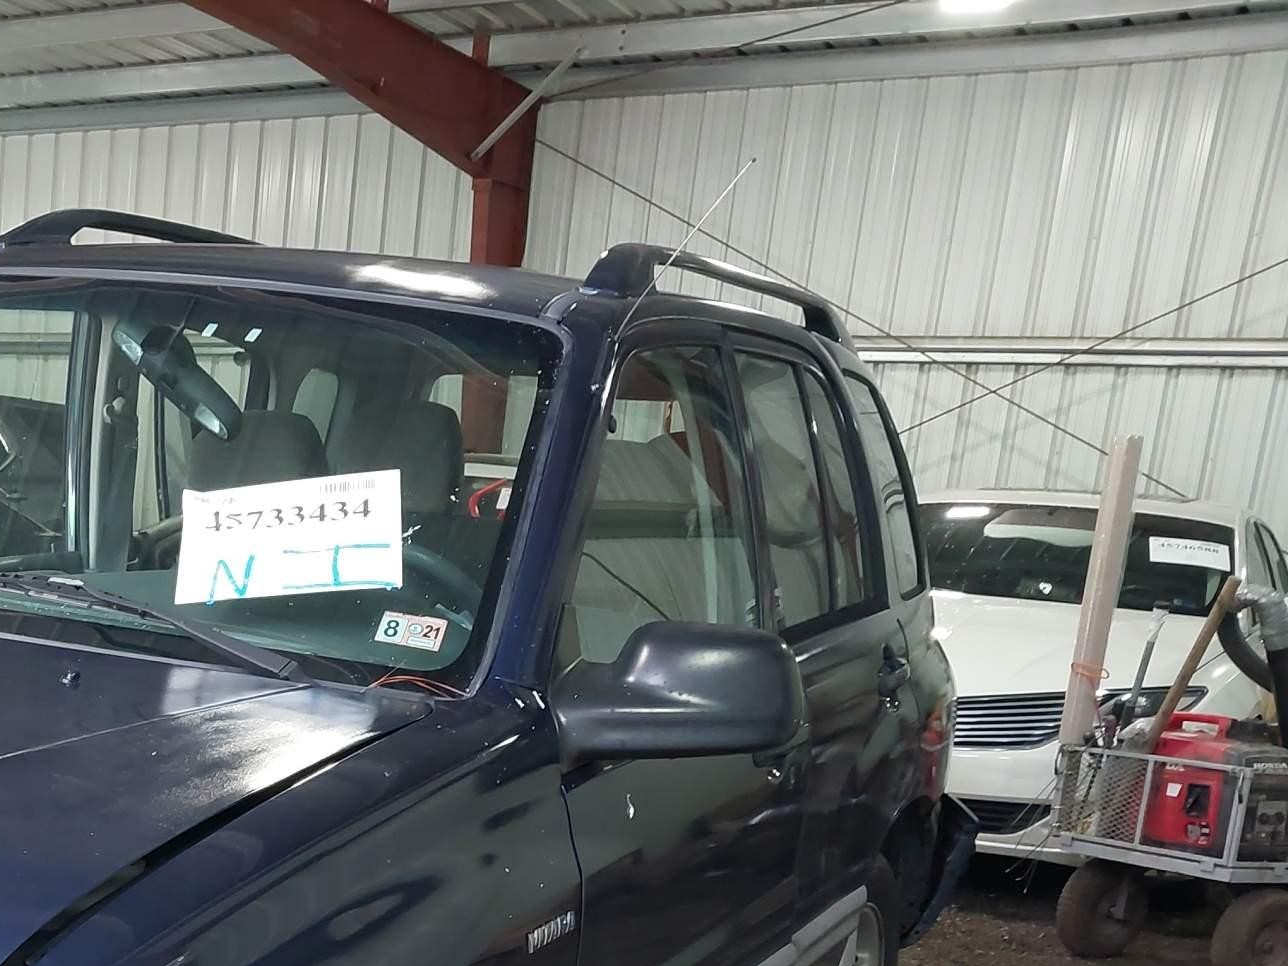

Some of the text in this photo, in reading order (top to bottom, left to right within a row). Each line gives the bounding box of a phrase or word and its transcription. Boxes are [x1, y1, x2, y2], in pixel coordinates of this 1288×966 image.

[205, 498, 372, 532] 45733434
[206, 553, 256, 606] N
[383, 619, 400, 638] 8
[421, 624, 441, 640] 21
